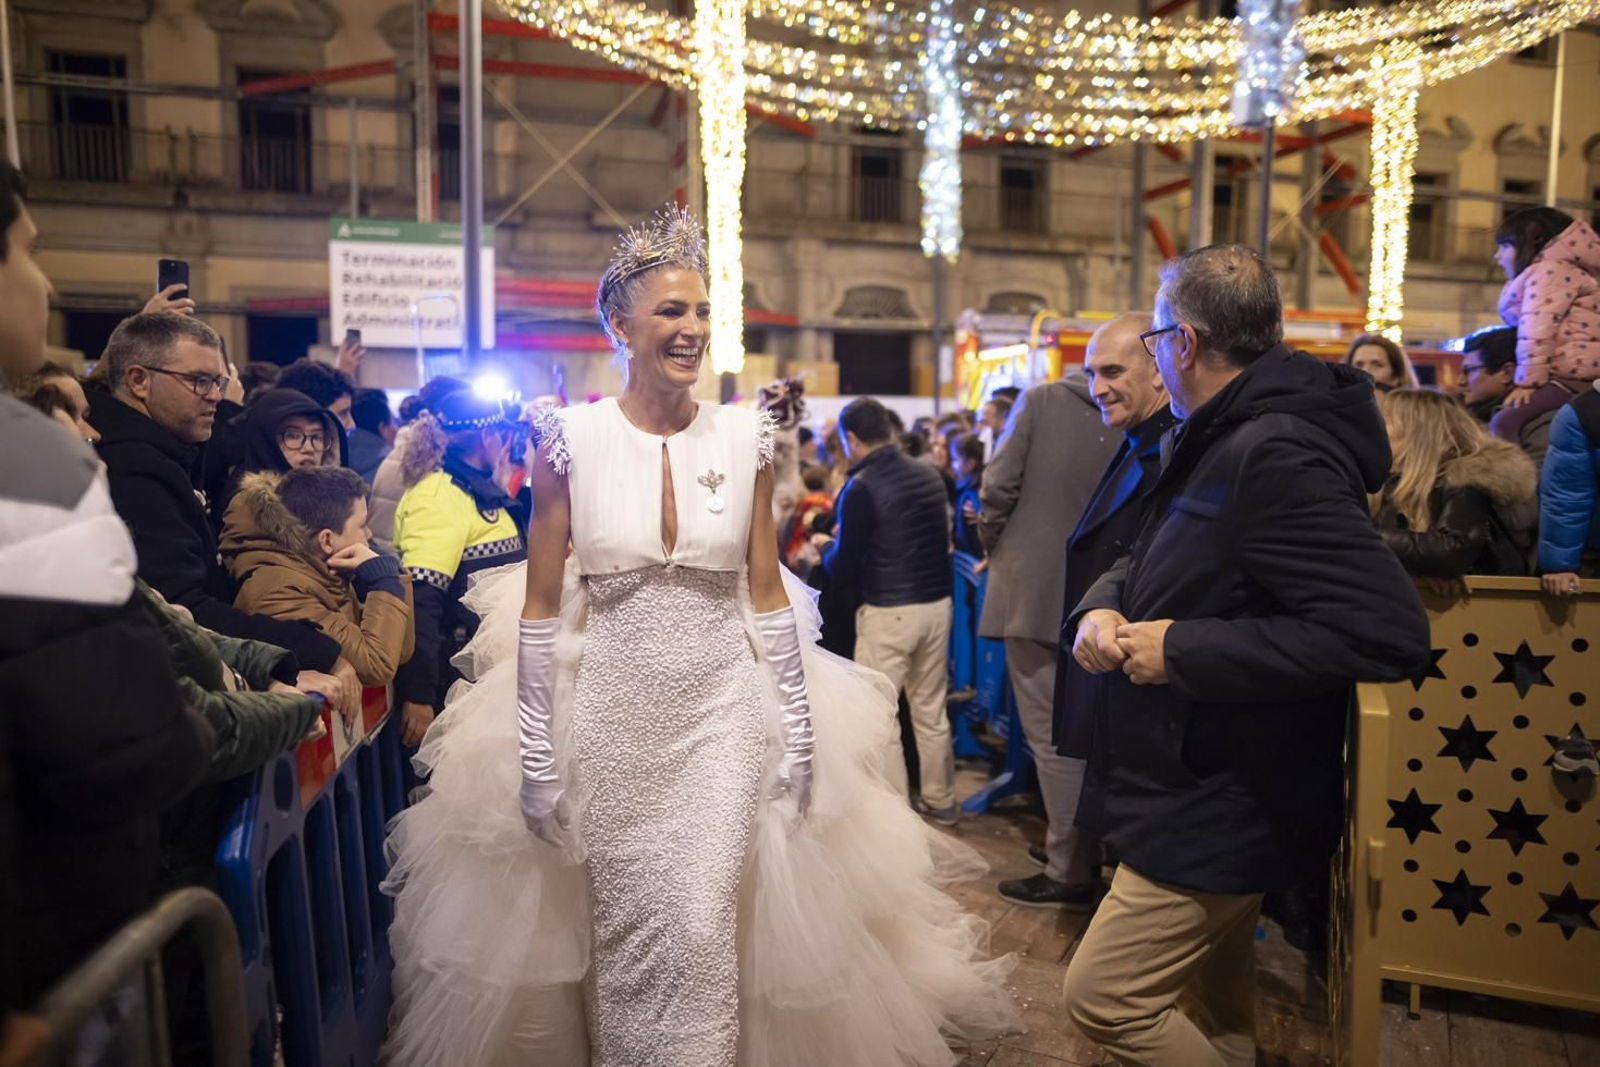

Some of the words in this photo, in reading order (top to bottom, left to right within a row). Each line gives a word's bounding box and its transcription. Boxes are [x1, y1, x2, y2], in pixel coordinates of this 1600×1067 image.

[341, 250, 456, 268] Terminación
[342, 272, 463, 289] Rehabilitació
[342, 293, 410, 308] Edificio
